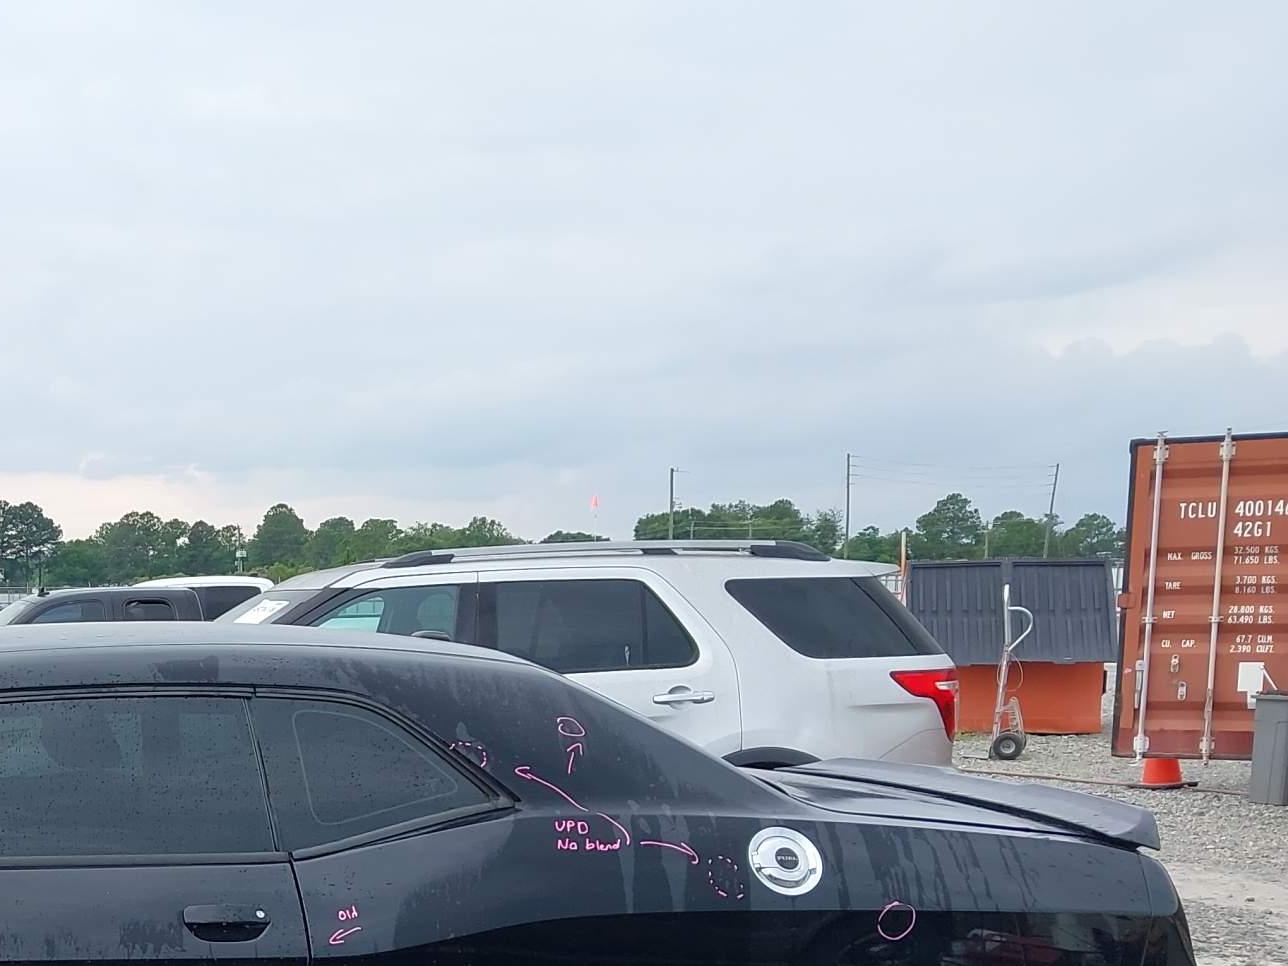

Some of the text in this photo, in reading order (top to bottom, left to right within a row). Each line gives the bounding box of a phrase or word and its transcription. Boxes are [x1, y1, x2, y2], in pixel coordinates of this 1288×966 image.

[1179, 501, 1217, 519] TCLU
[1233, 521, 1272, 537] 42G1
[1233, 545, 1260, 554] 32.500
[1191, 551, 1213, 560] GROSS
[1233, 555, 1280, 564] 71.650 LBS.
[1235, 575, 1278, 584] 3.700 KGS.
[1165, 581, 1182, 590] TARE
[1235, 585, 1257, 594] 8.160
[1228, 605, 1276, 614] 28.800 KGS.
[1162, 610, 1176, 619] NET
[1227, 615, 1274, 624] 63.490 LBS.
[1235, 634, 1253, 643] 67.7
[1161, 639, 1197, 648] CU. CAP.
[1229, 645, 1251, 653] 2.390
[555, 820, 589, 834] UPD
[585, 838, 621, 851] blend
